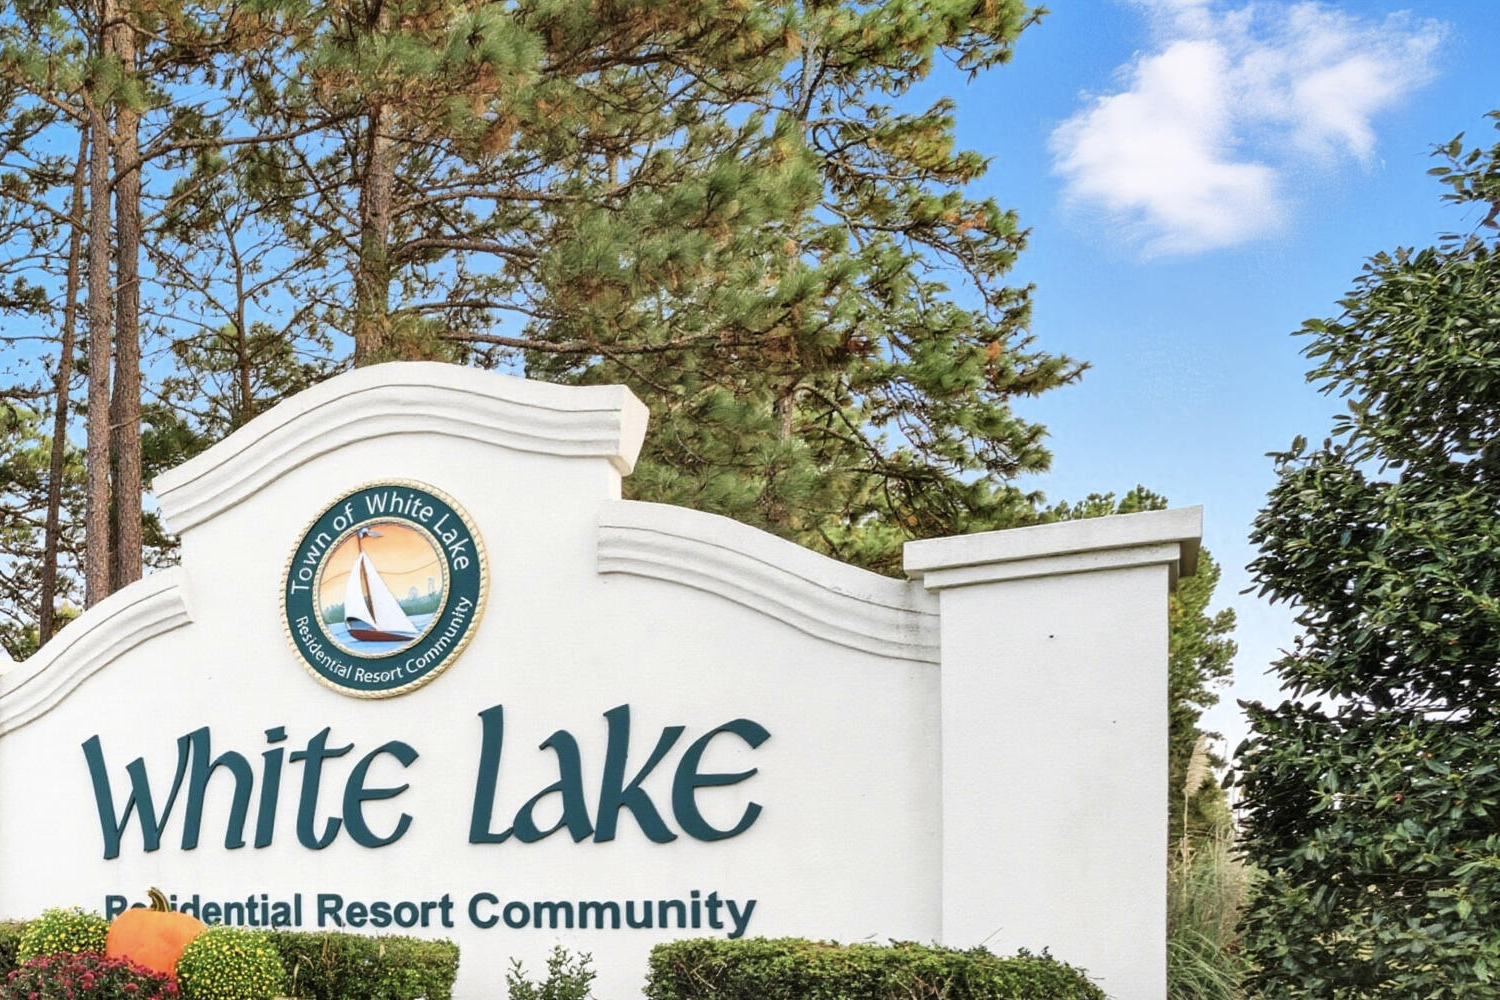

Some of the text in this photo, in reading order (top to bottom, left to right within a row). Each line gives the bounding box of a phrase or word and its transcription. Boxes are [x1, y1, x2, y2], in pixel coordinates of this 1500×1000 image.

[291, 491, 470, 595] Town of White Lake
[295, 596, 474, 684] Residential Resort Community
[81, 703, 772, 860] White Lake
[317, 893, 454, 928] Resort
[468, 890, 757, 939] Community
